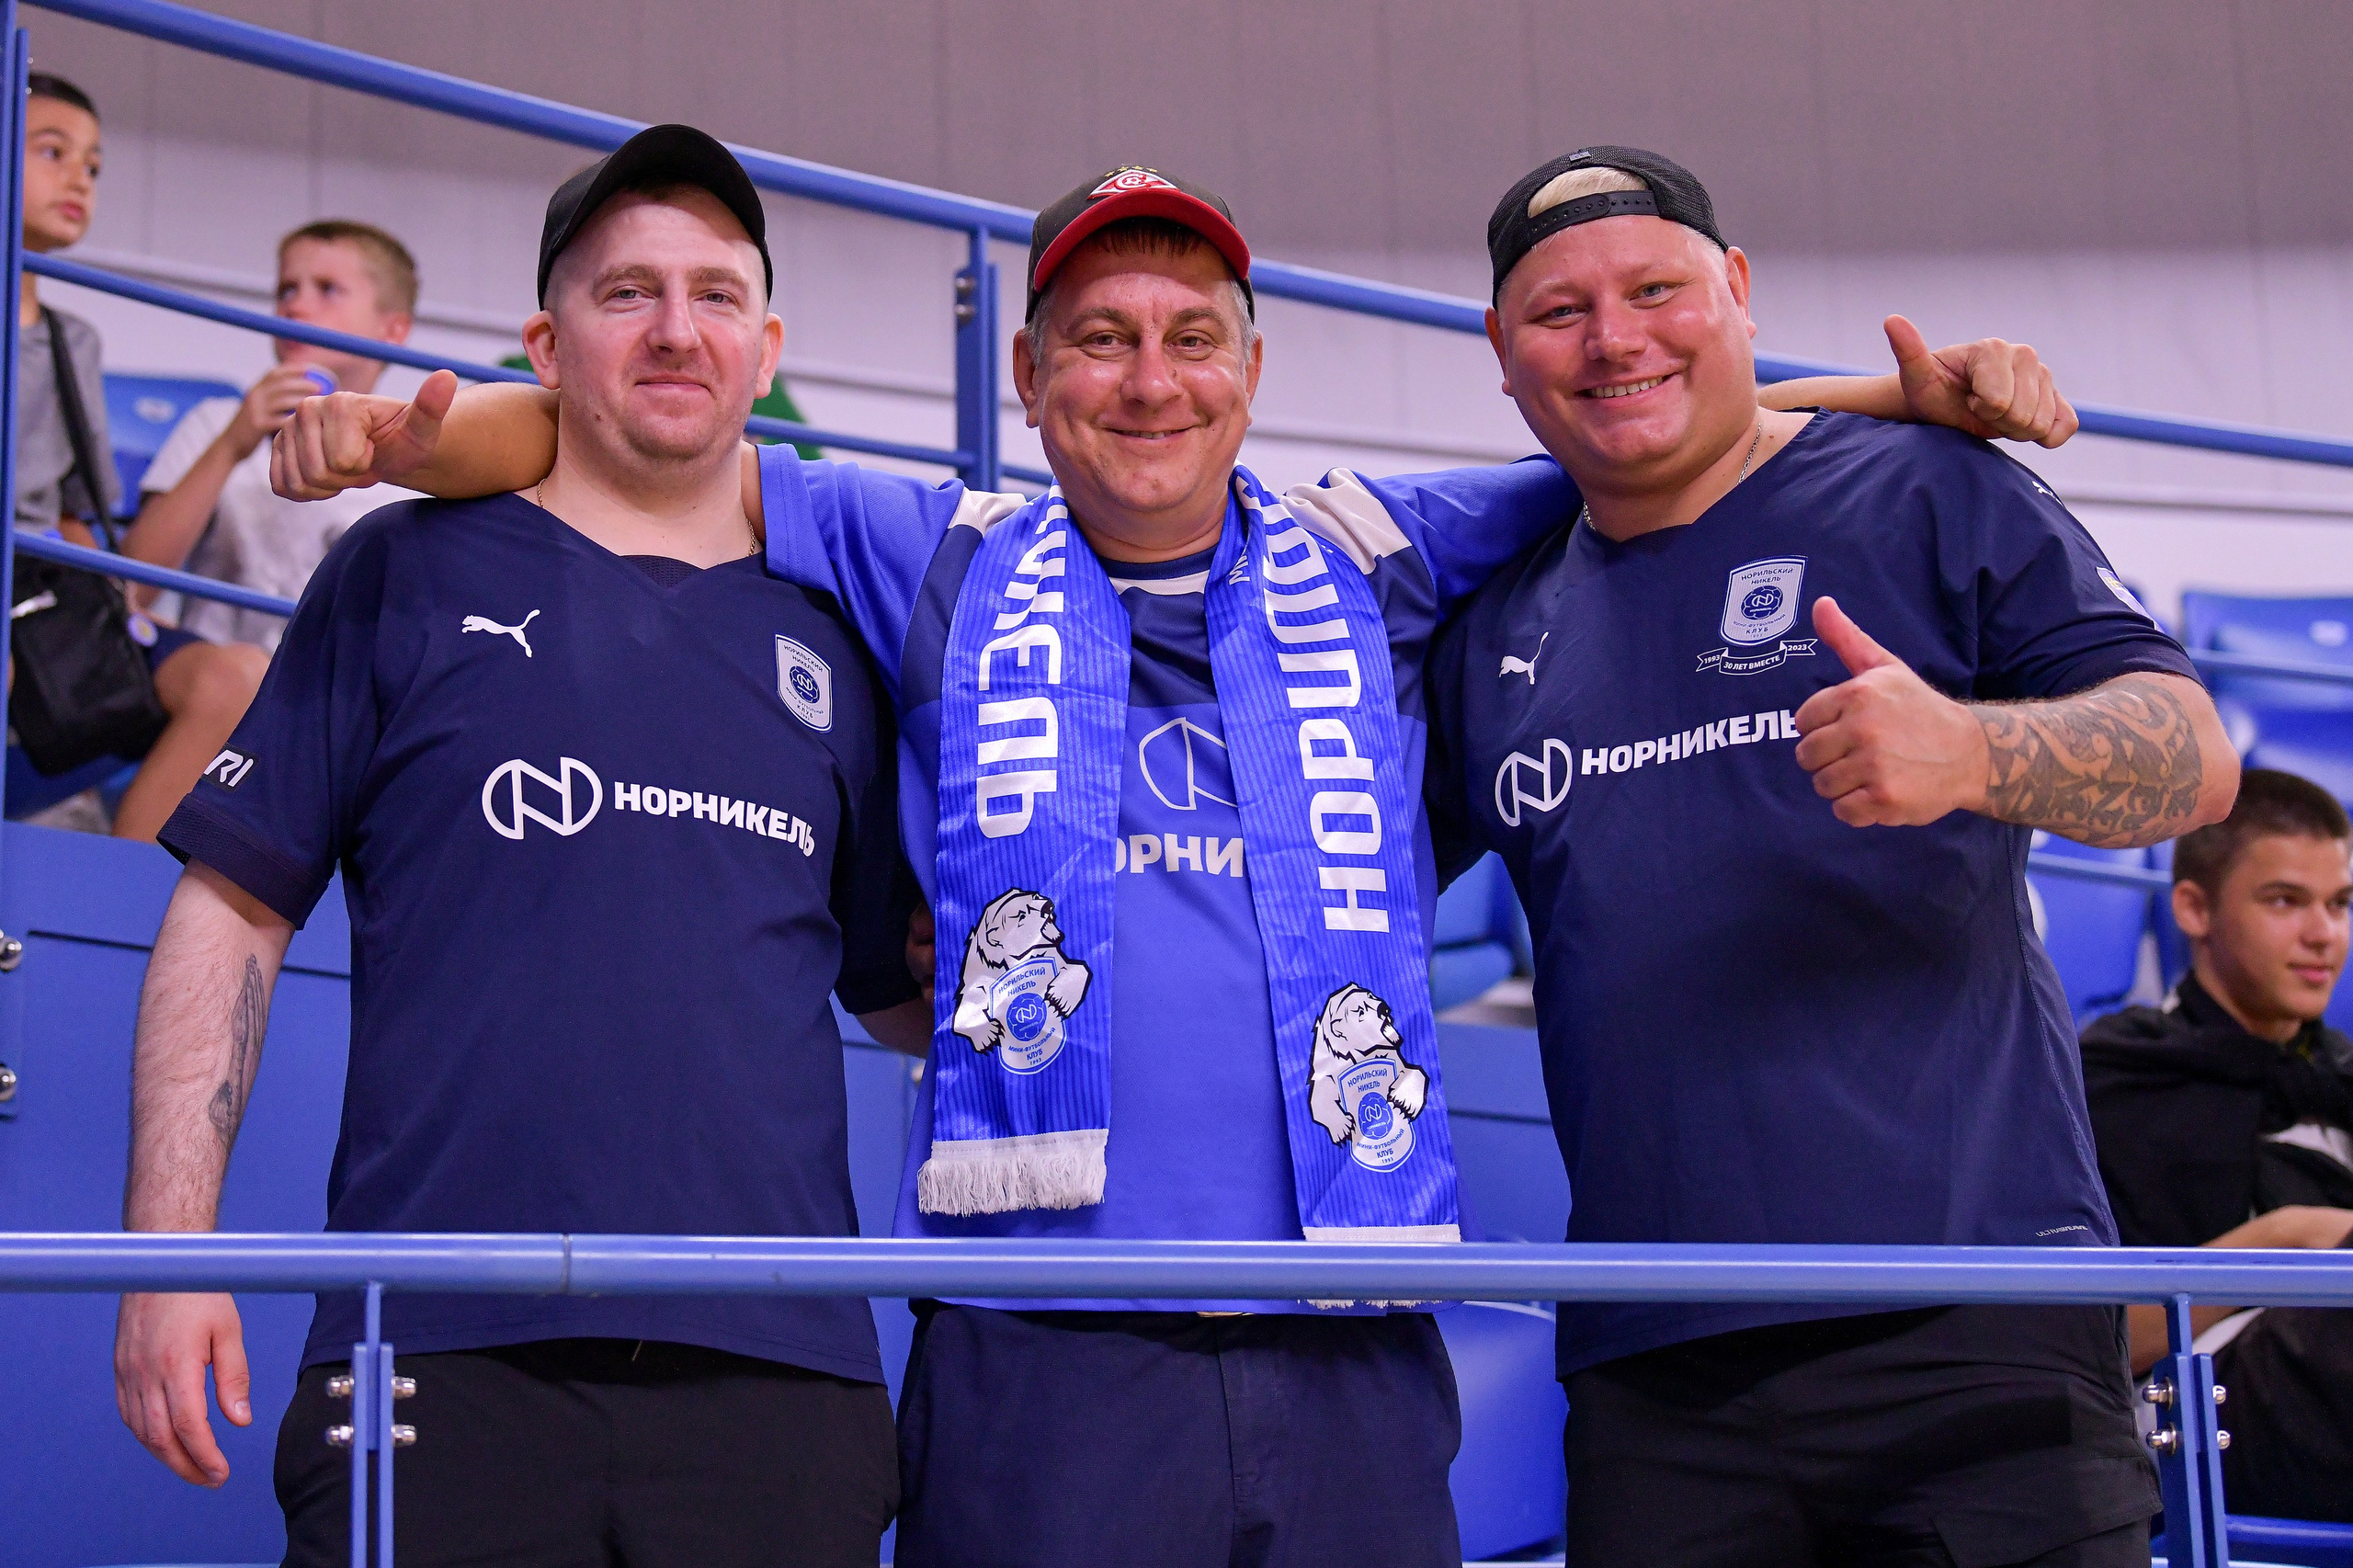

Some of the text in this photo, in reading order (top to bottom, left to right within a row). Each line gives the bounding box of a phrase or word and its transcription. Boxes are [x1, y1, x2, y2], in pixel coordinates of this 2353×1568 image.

[1741, 567, 1794, 581] НОРИЛЬСКИЙ
[1750, 576, 1781, 585] НИКЕЛЬ
[1703, 654, 1721, 665] 1993
[1723, 654, 1780, 671] 30 ЛЕТ ВМЕСТЕ
[1580, 709, 1802, 776] НОРНИКЕЛЬ
[614, 781, 815, 858] НОРНИКЕЛЬ
[998, 966, 1047, 994] НОРИЛЬСКИЙ
[1007, 980, 1037, 997] НИКЕЛЬ
[1026, 1048, 1043, 1062] КЛУБ
[1347, 1068, 1388, 1088] НОРИЛЬСКИЙ
[1358, 1080, 1381, 1093] НИКЕЛЬ
[1376, 1148, 1394, 1158] КЛУБ
